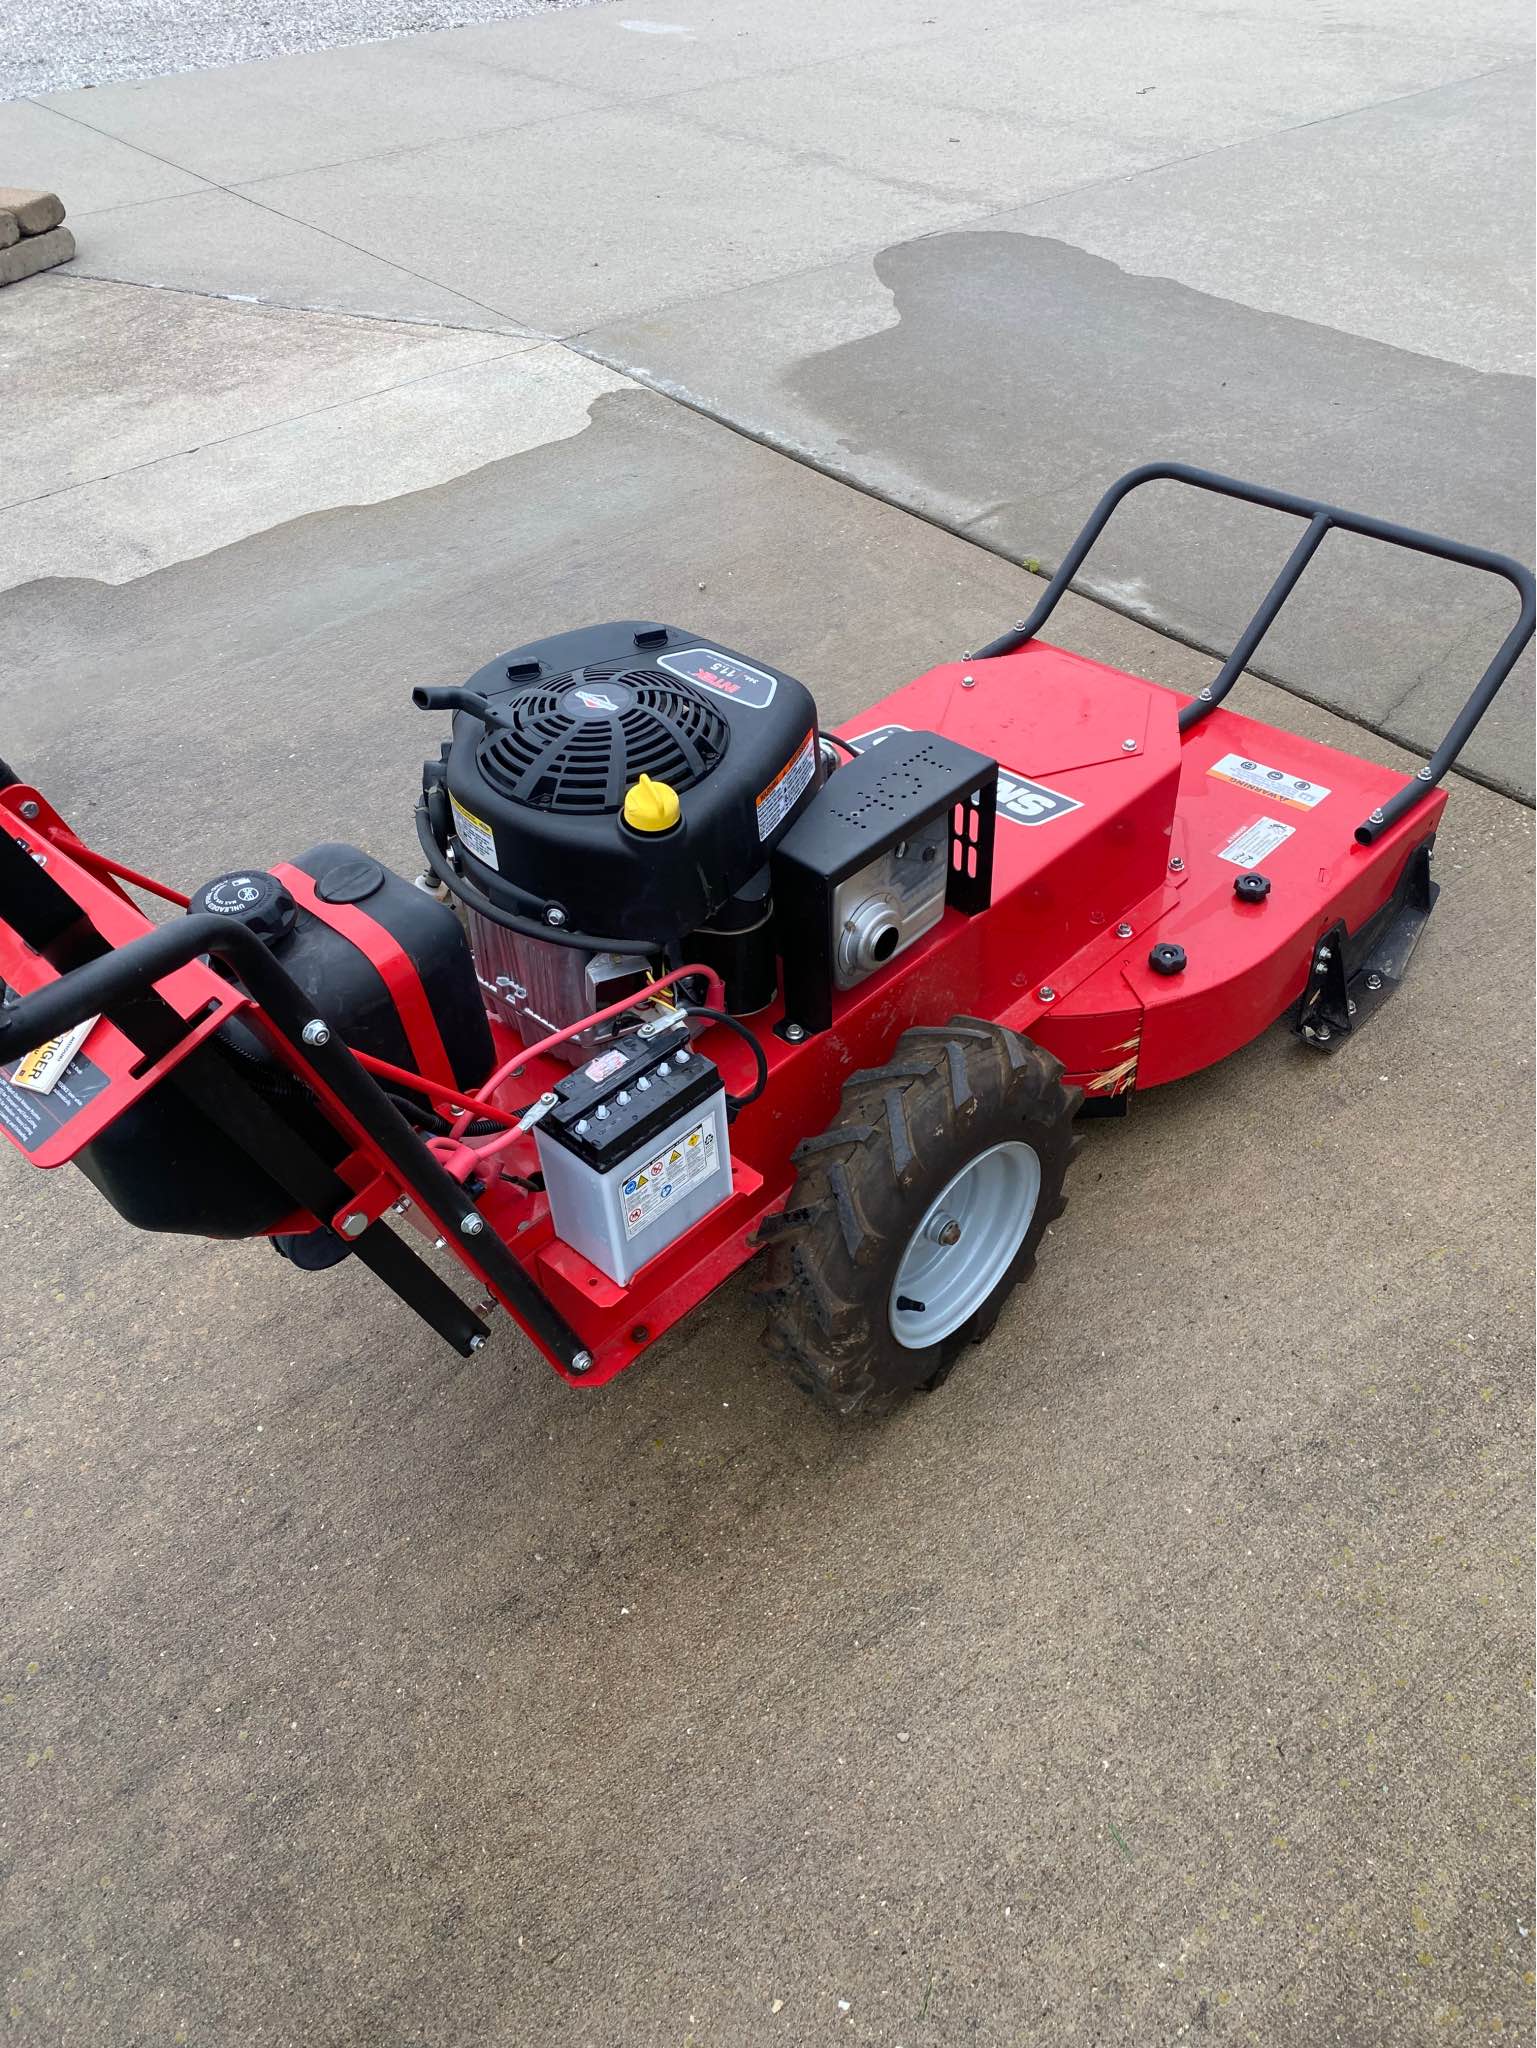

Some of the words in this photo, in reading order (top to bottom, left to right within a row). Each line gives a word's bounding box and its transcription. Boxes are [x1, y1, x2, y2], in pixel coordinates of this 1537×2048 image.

[691, 668, 741, 693] INTEK
[710, 663, 737, 677] 11.5
[1230, 777, 1278, 798] WARNING
[208, 903, 245, 912] UNLEADED
[28, 1039, 63, 1080] TIGER
